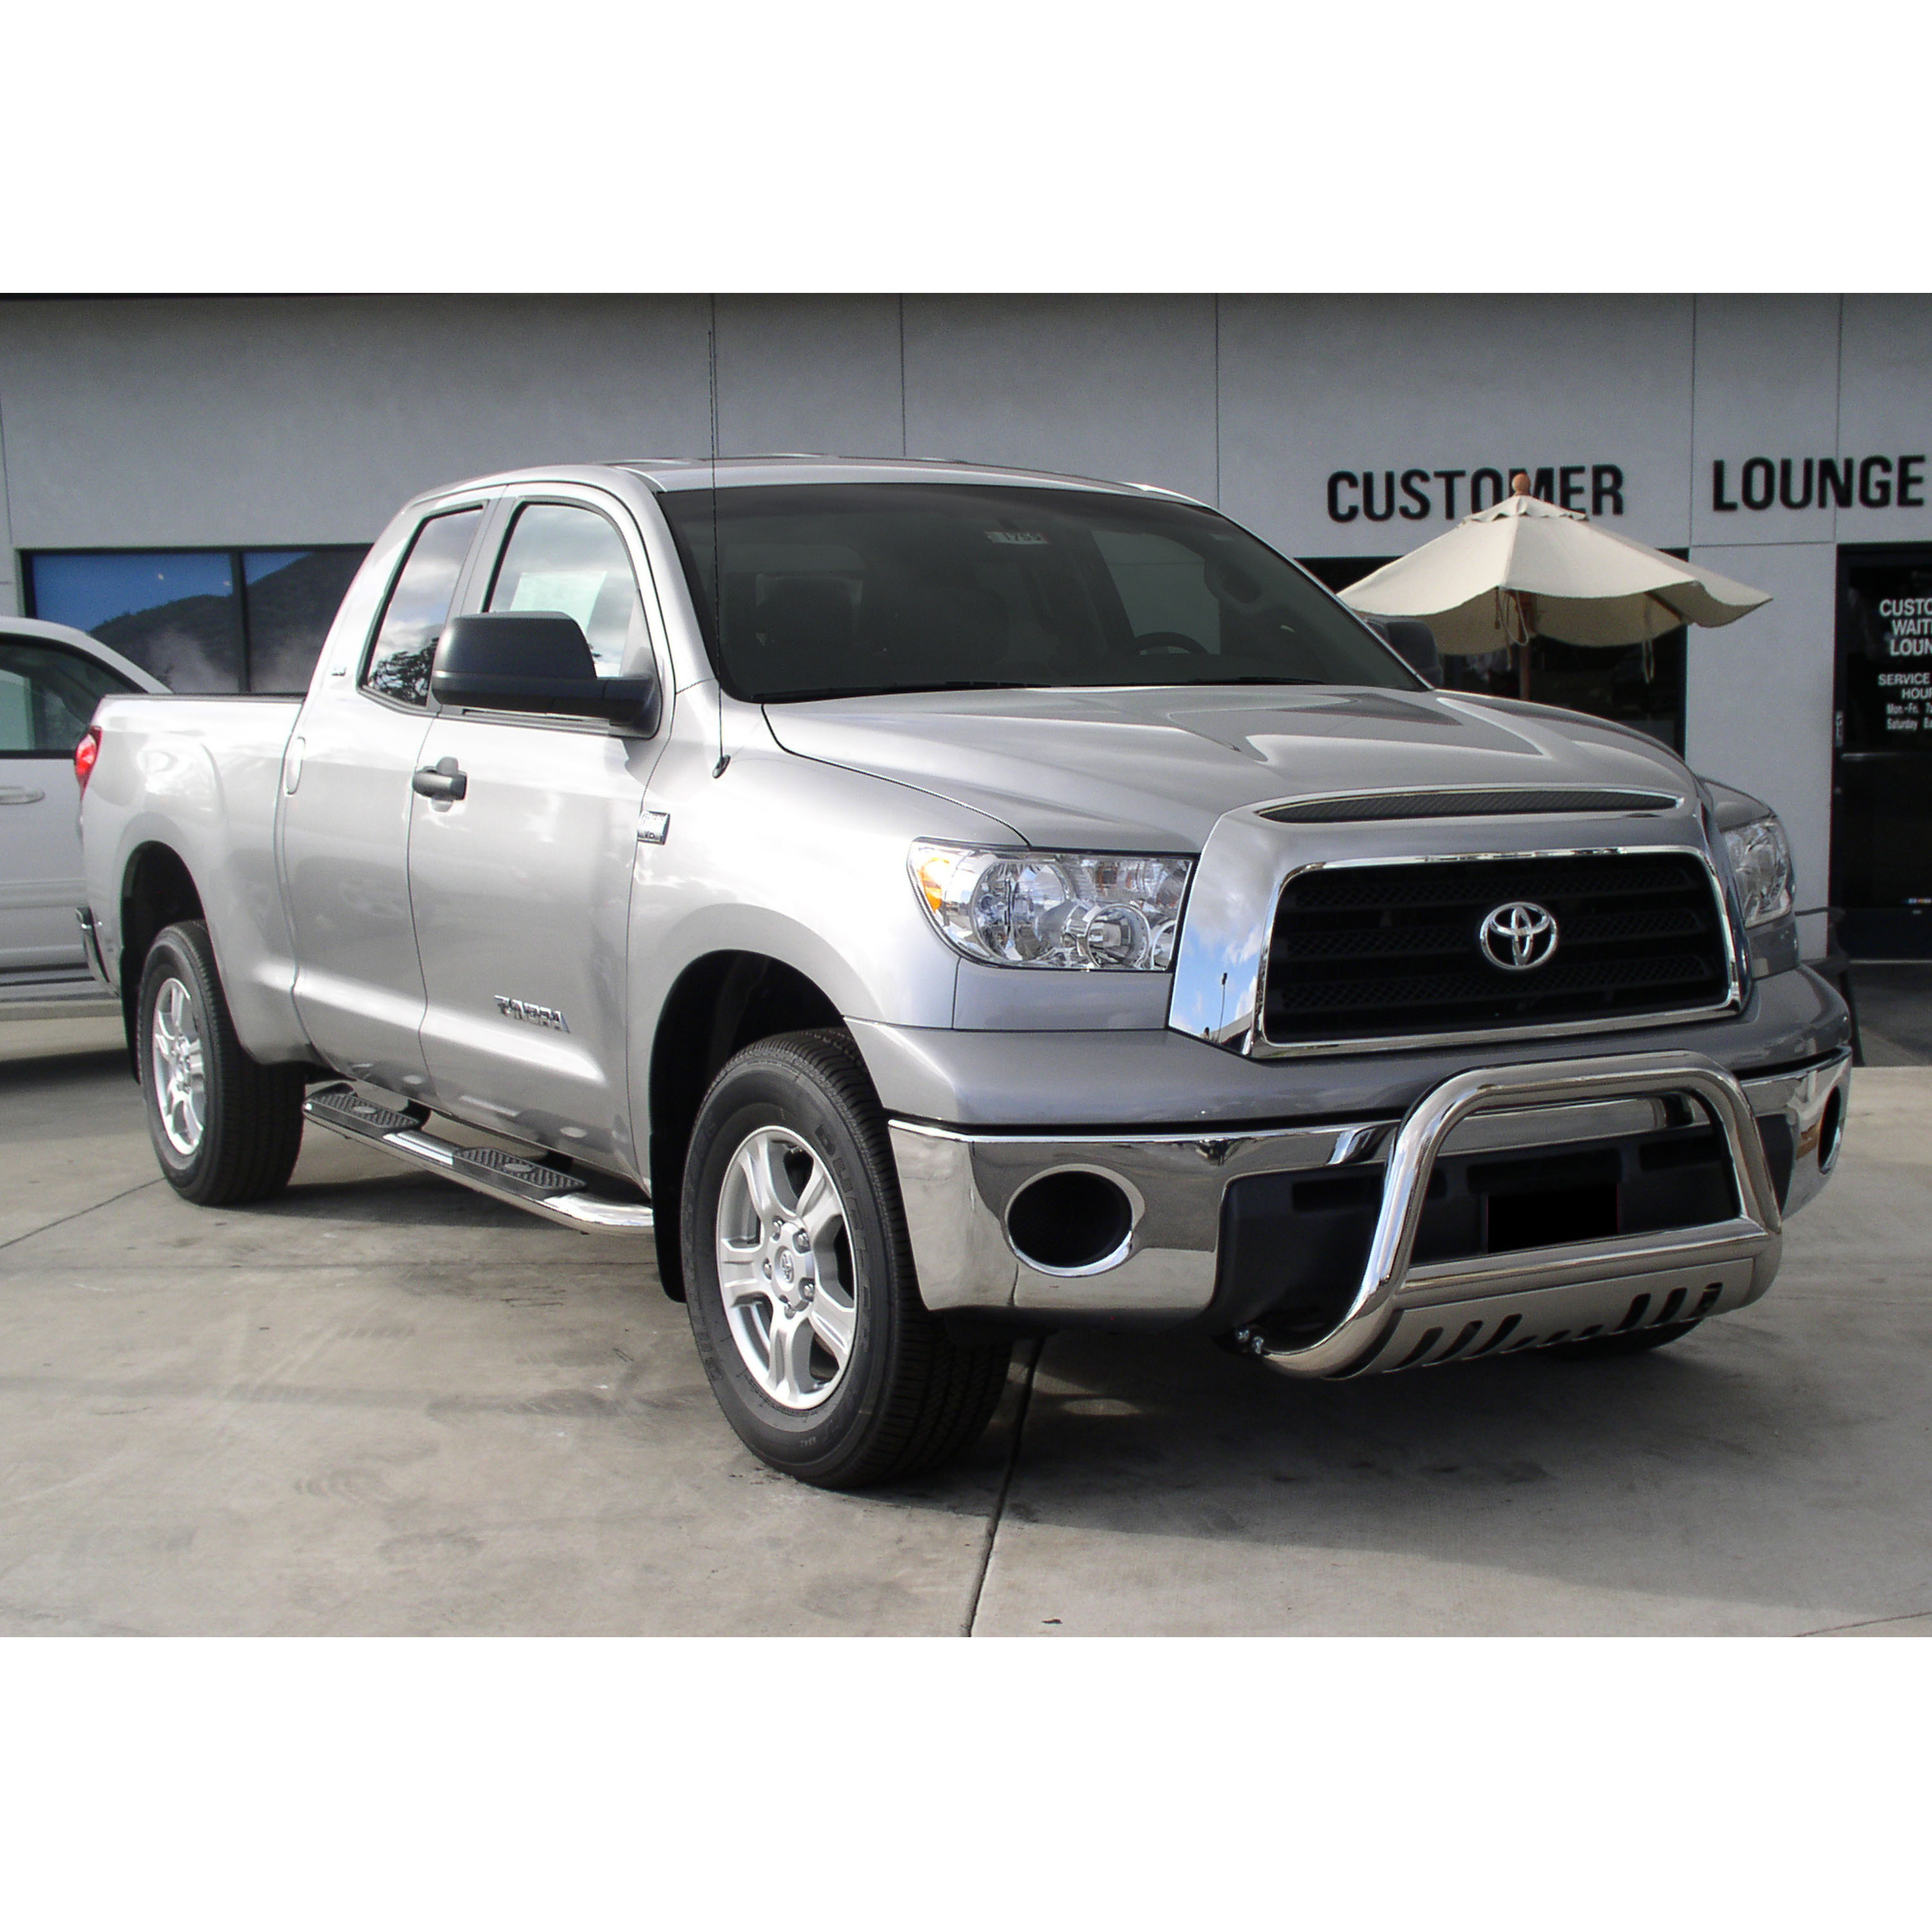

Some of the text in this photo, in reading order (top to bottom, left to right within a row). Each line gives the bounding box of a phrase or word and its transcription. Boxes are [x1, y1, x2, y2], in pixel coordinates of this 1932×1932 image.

[1712, 455, 1926, 512] LOUNGE
[1879, 673, 1930, 686] SERVICE
[1886, 717, 1918, 731] Saturday
